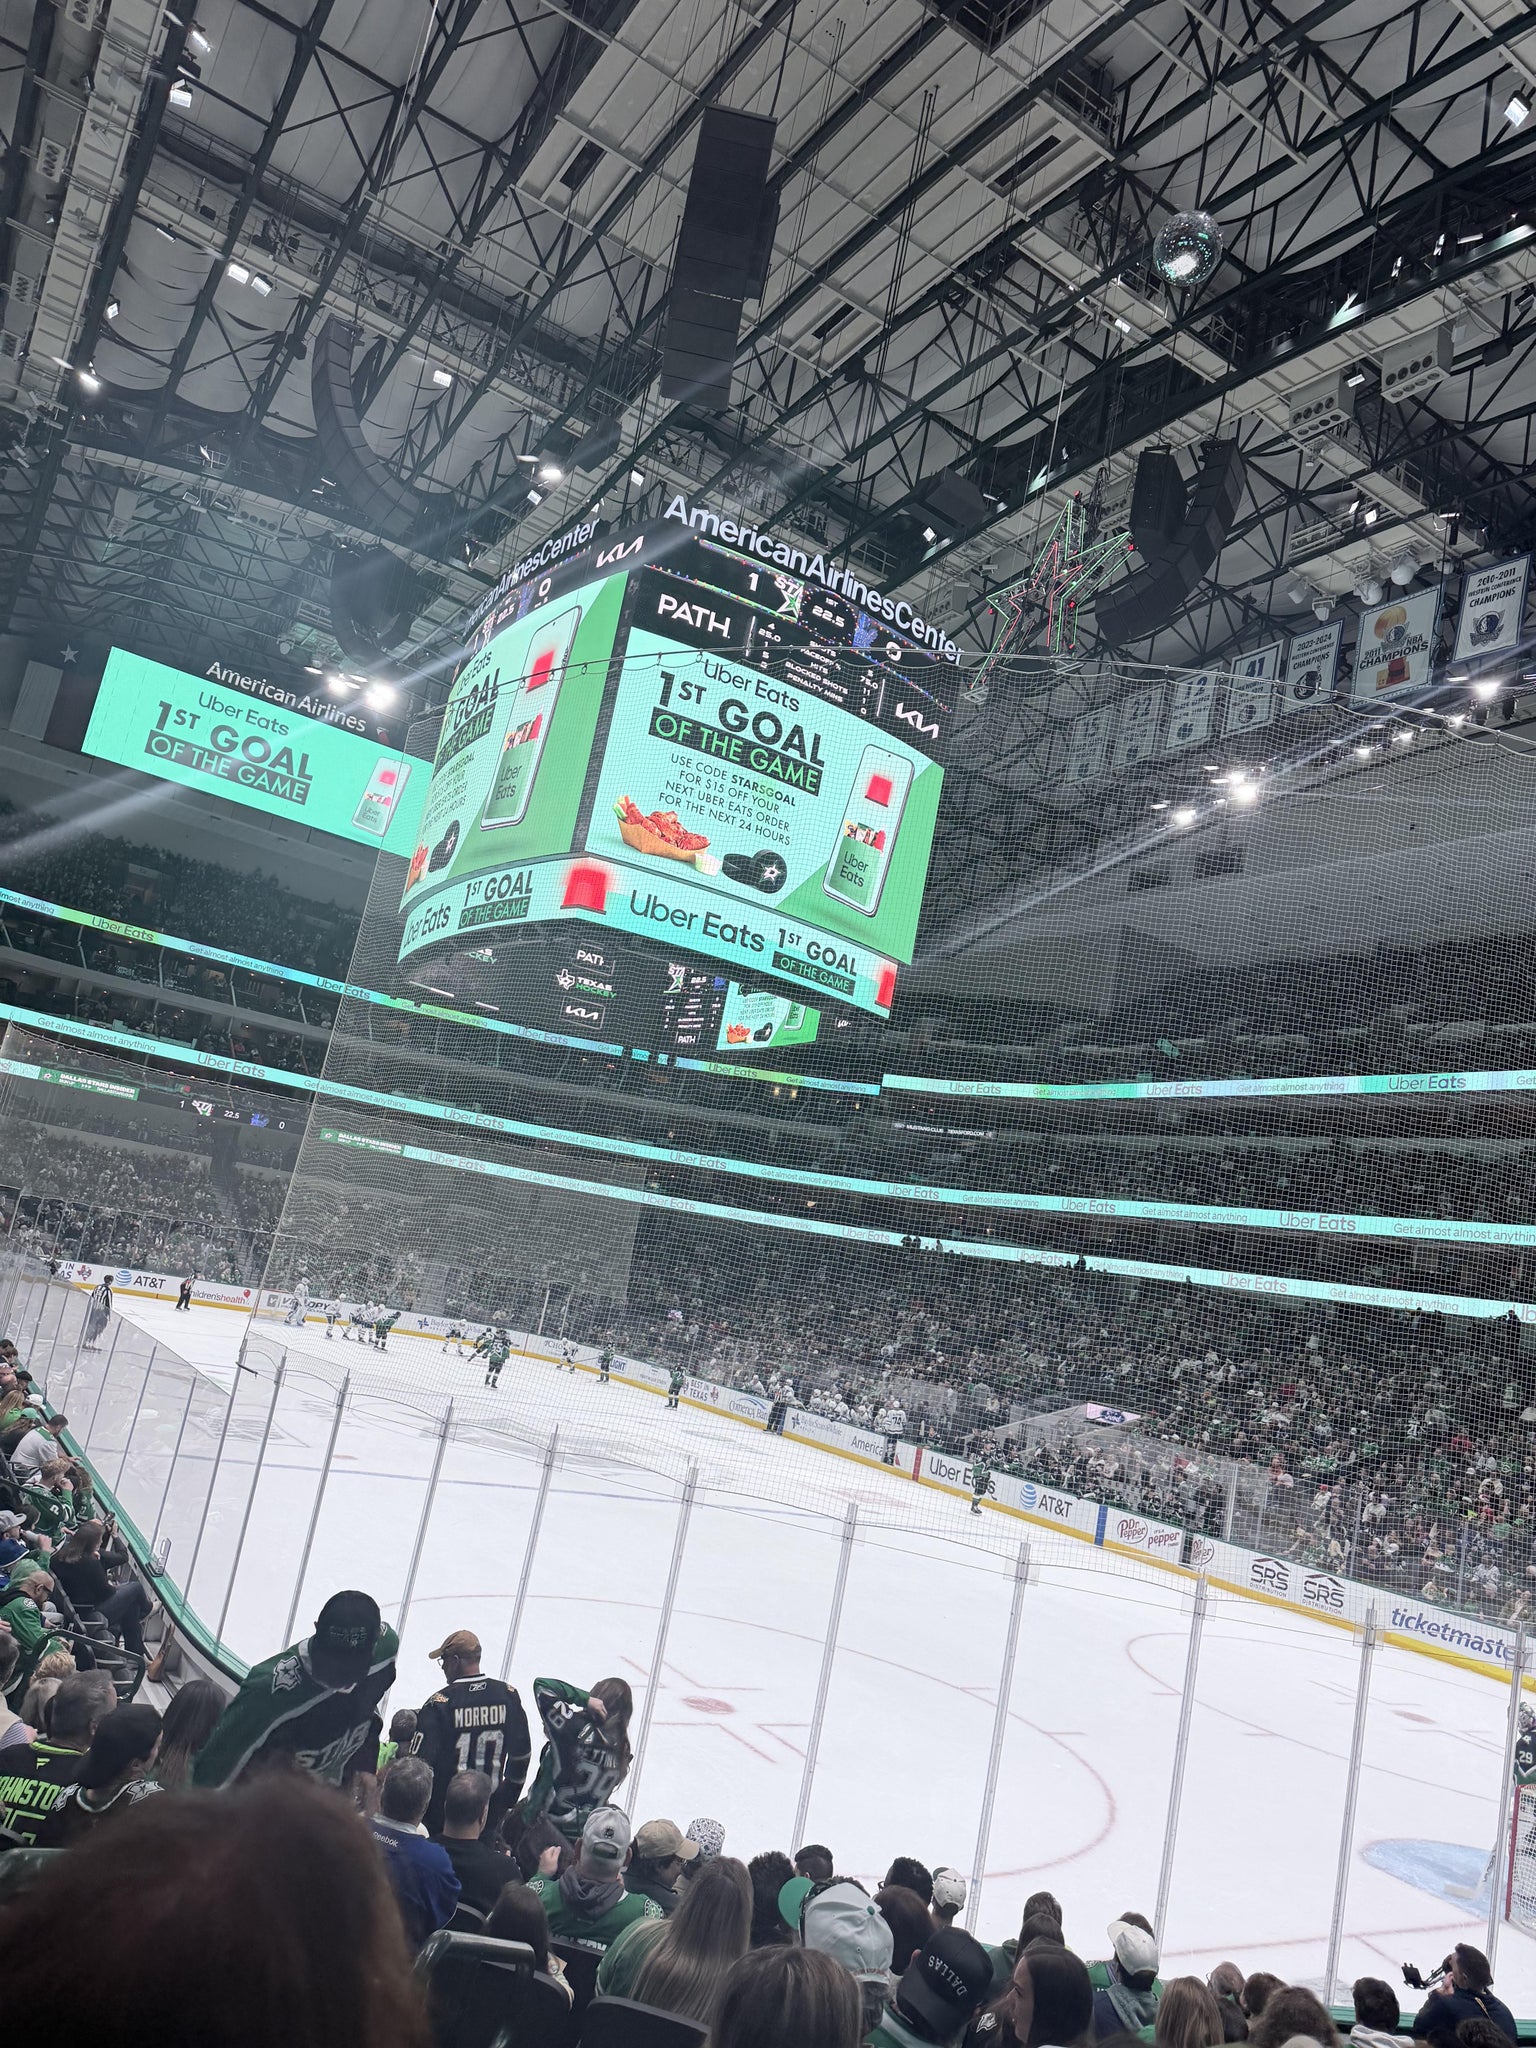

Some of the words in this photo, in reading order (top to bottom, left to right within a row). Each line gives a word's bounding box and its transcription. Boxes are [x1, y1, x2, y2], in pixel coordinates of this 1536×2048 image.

[539, 578, 551, 597] 0
[749, 572, 759, 592] 1
[1476, 567, 1516, 588] 2010-2011
[1469, 587, 1516, 608] CHAMPIONS
[812, 605, 845, 628] 22.5
[885, 642, 901, 661] 0
[1296, 632, 1333, 651] 2023-2024
[1406, 634, 1423, 645] NBA
[758, 628, 781, 642] 25.0
[860, 675, 878, 690] 75.0
[1292, 652, 1330, 670] CHAMPIONS
[1359, 641, 1429, 670] CHAMPIONS
[1364, 647, 1381, 660] 2011
[785, 661, 822, 682] BLOCKED
[823, 679, 848, 695] SHOTS
[810, 661, 829, 674] HITS
[1246, 656, 1266, 677] 41
[206, 661, 297, 710] American
[298, 695, 367, 733] Airlines
[704, 658, 752, 692] Uber
[754, 683, 801, 713] Eats
[787, 672, 823, 692] PENALTY
[823, 689, 844, 703] MINS
[198, 691, 244, 720] Uber
[244, 709, 290, 737] Eats
[660, 670, 707, 707] 1ST
[717, 699, 825, 768] GOAL
[157, 701, 201, 732] 1ST
[210, 724, 314, 781] GOAL
[655, 714, 692, 743] OF
[700, 727, 742, 763] THE
[750, 748, 820, 793] GAME
[151, 736, 185, 759] OF
[190, 746, 231, 777] THE
[237, 764, 309, 803] GAME
[671, 753, 693, 768] USE
[695, 761, 728, 782] CODE
[731, 774, 796, 808] STARSGOAL
[679, 770, 703, 786] FOR
[704, 778, 726, 795] $15
[728, 785, 750, 801] OFF
[751, 794, 780, 815] YOUR
[665, 781, 695, 800] NEXT
[697, 790, 725, 809] UBER
[727, 799, 753, 817] EATS
[755, 808, 790, 832] ORDER
[658, 792, 680, 809] FOR
[682, 800, 706, 816] THE
[708, 808, 737, 827] NEXT
[739, 818, 752, 832] 24
[754, 823, 791, 847] HOURS
[843, 850, 869, 874] Uber
[839, 864, 865, 888] Eats
[421, 902, 451, 936] Eats
[464, 880, 483, 907] 1ST
[484, 870, 533, 902] GOAL
[460, 910, 474, 927] OF
[473, 907, 491, 923] THE
[491, 899, 528, 920] GAME
[629, 889, 698, 931] Uber
[702, 911, 766, 952] Eats
[778, 928, 802, 949] 1ST
[806, 941, 858, 977] GOAL
[92, 915, 122, 933] Uber
[124, 926, 154, 942] Eats
[316, 977, 343, 993] Uber
[577, 977, 613, 991] TEXAS
[780, 957, 798, 972] OF
[798, 962, 819, 979] THE
[819, 969, 850, 992] GAME
[576, 983, 617, 999] HOCKEY
[678, 1036, 696, 1044] PATH
[60, 1073, 87, 1085] DALLAS
[87, 1079, 109, 1089] STARS
[109, 1084, 135, 1094] INSIDER
[1388, 1076, 1425, 1091] Uber
[1428, 1075, 1467, 1090] Eats
[38, 1016, 54, 1030] Get
[55, 1020, 86, 1036] almost
[87, 1028, 117, 1043] almost
[118, 1035, 156, 1052] anything
[197, 1053, 231, 1070] Uber
[233, 1063, 265, 1078] Eats
[443, 1108, 473, 1123] Uber
[475, 1114, 505, 1130] Eats
[670, 1152, 698, 1166] Uber
[700, 1156, 727, 1170] Eats
[887, 1183, 912, 1197] Uber
[914, 1186, 939, 1200] Eats
[1061, 1199, 1087, 1212] Uber
[1088, 1200, 1116, 1214] Eats
[1279, 1213, 1316, 1230] Uber
[1318, 1215, 1356, 1232] Eats
[1393, 1222, 1414, 1234] Get
[1415, 1224, 1451, 1238] almost
[1453, 1227, 1491, 1241] almost
[224, 1109, 240, 1120] 22.5
[279, 1121, 285, 1130] 0
[133, 1275, 167, 1290] AT&T
[1220, 1273, 1252, 1289] Uber
[1254, 1276, 1288, 1293] Eats
[689, 1389, 709, 1402] TEXAS
[690, 1379, 703, 1389] BEST
[929, 1456, 962, 1482] Uber
[963, 1467, 996, 1495] Es
[1038, 1493, 1073, 1518] AT&T
[1120, 1519, 1146, 1541] Pepper
[1128, 1518, 1140, 1530] Dr
[1148, 1531, 1180, 1549] pepper
[1251, 1561, 1290, 1592] SRS
[1249, 1581, 1288, 1598] DISTRIBUTION
[1303, 1577, 1345, 1609] SRS
[1302, 1598, 1343, 1616] DISTRIBUTION
[1391, 1607, 1517, 1662] ticketmaste
[454, 1704, 507, 1729] MORROW
[455, 1729, 505, 1794] 10
[1519, 1750, 1533, 1764] 29
[0, 1775, 66, 1811] OHNSTO
[373, 1831, 399, 1848] Reebok
[928, 1955, 968, 1997] DALLAS
